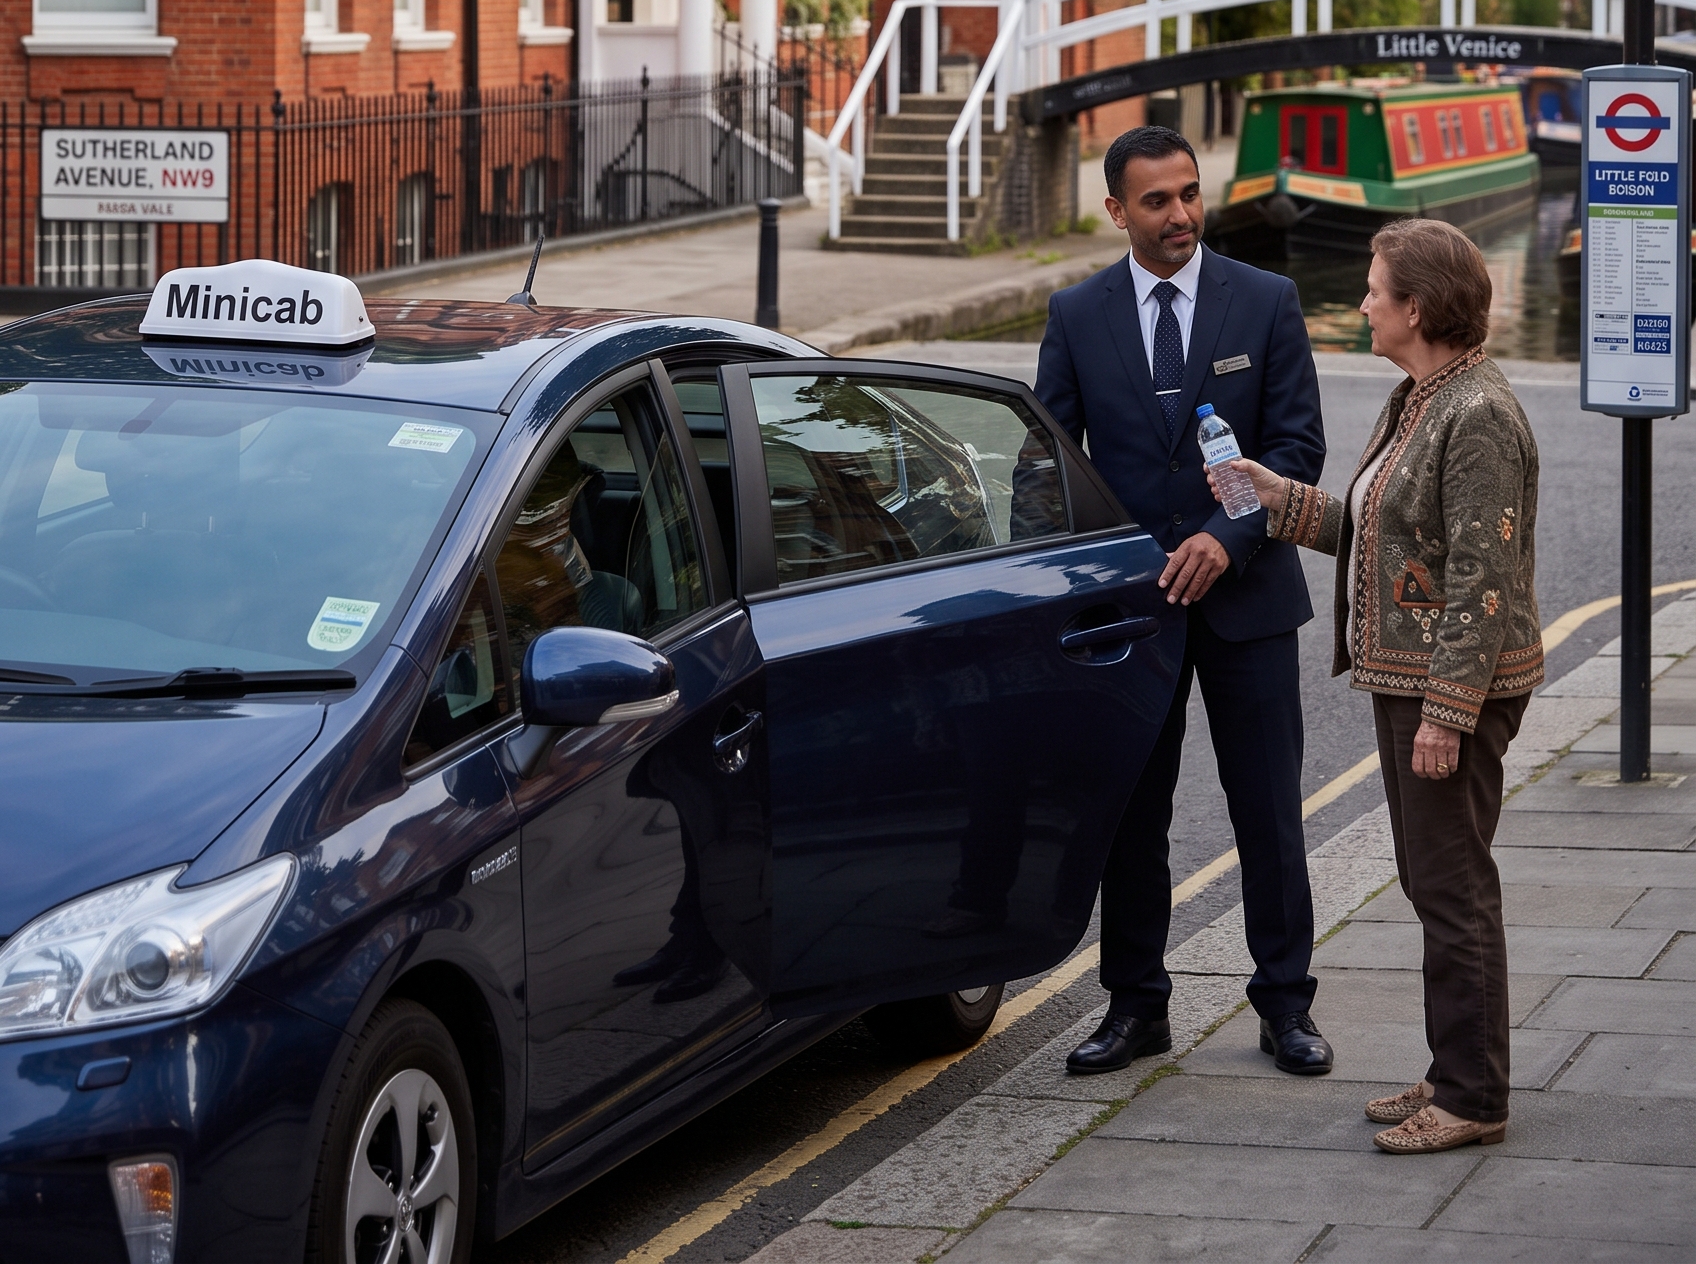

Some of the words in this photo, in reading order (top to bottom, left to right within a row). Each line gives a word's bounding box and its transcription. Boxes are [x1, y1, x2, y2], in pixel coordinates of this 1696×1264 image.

[1376, 33, 1440, 58] Little
[1443, 34, 1522, 59] Venice
[55, 138, 214, 161] SUTHERLAND
[54, 166, 153, 190] AVENUE,
[162, 168, 214, 189] NW9
[1595, 169, 1635, 182] LITTLE
[165, 283, 324, 326] Minicab
